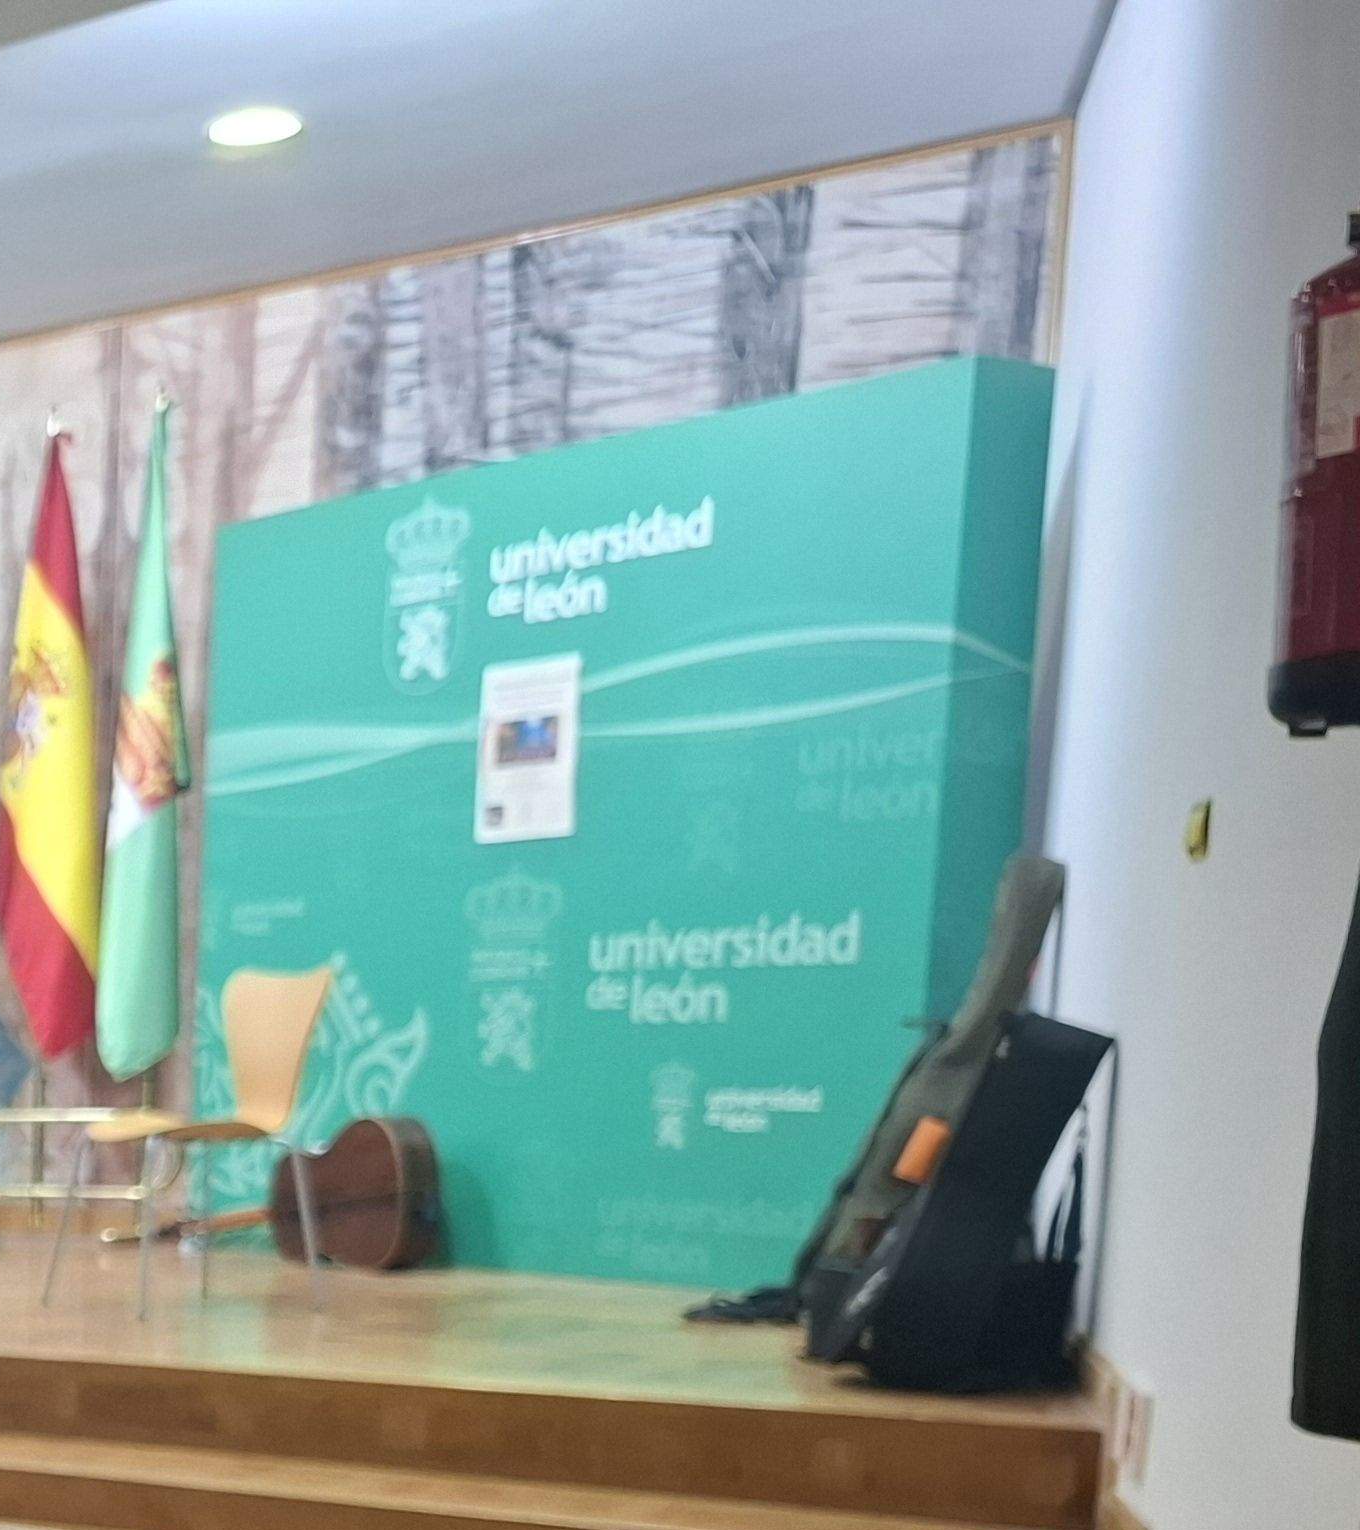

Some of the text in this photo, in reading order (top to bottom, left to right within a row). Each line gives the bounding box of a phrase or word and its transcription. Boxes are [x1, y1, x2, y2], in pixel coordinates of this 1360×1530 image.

[489, 495, 715, 584] universidad
[523, 569, 608, 624] león
[588, 908, 862, 972] universidad
[629, 971, 729, 1025] león
